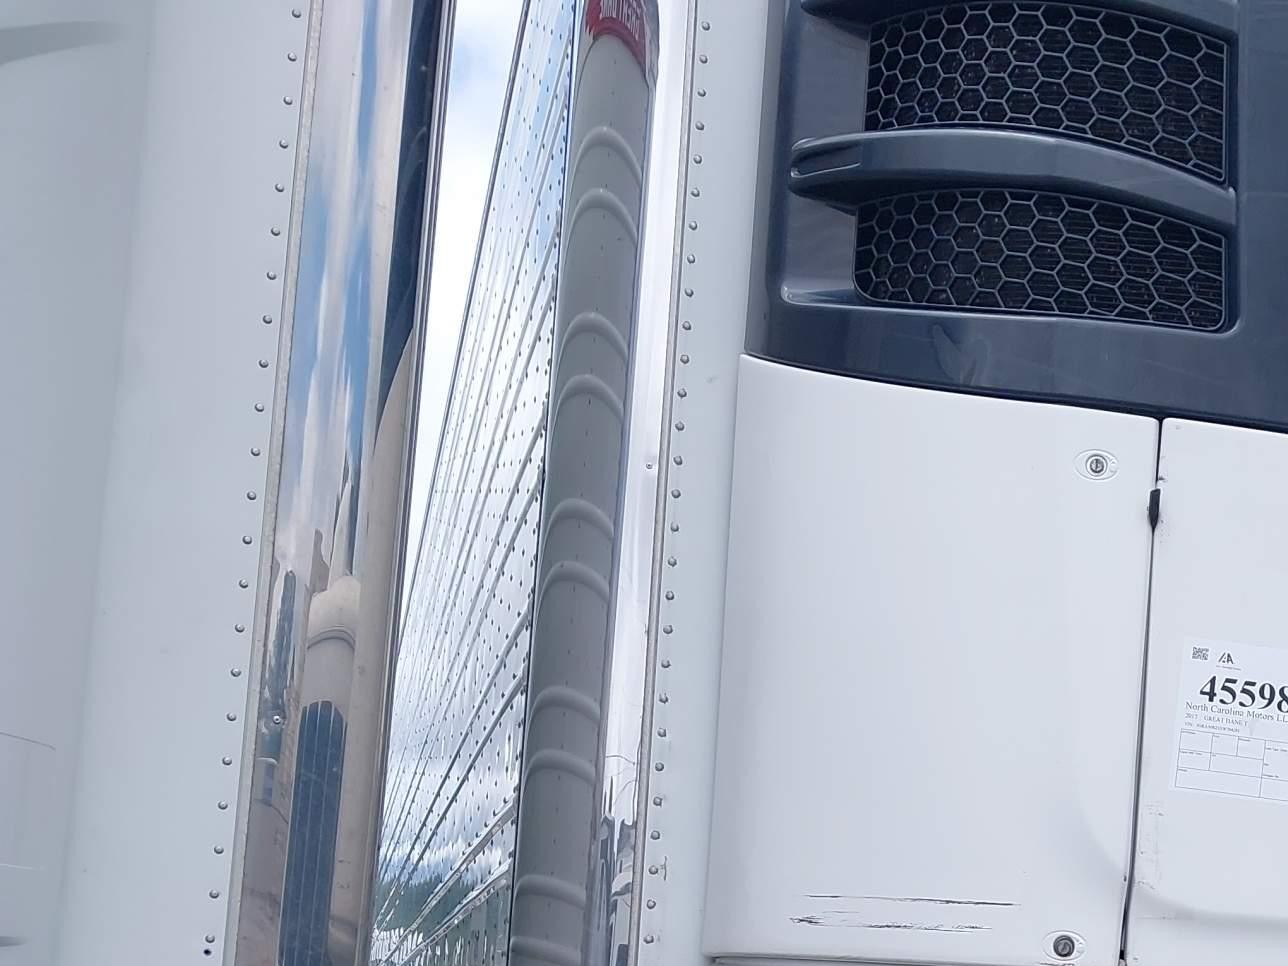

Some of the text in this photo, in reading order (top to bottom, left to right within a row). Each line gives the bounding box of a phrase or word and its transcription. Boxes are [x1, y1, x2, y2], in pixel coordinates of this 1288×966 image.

[1185, 702, 1208, 712] North
[1211, 704, 1244, 716] Carolina
[1247, 710, 1274, 721] Motors
